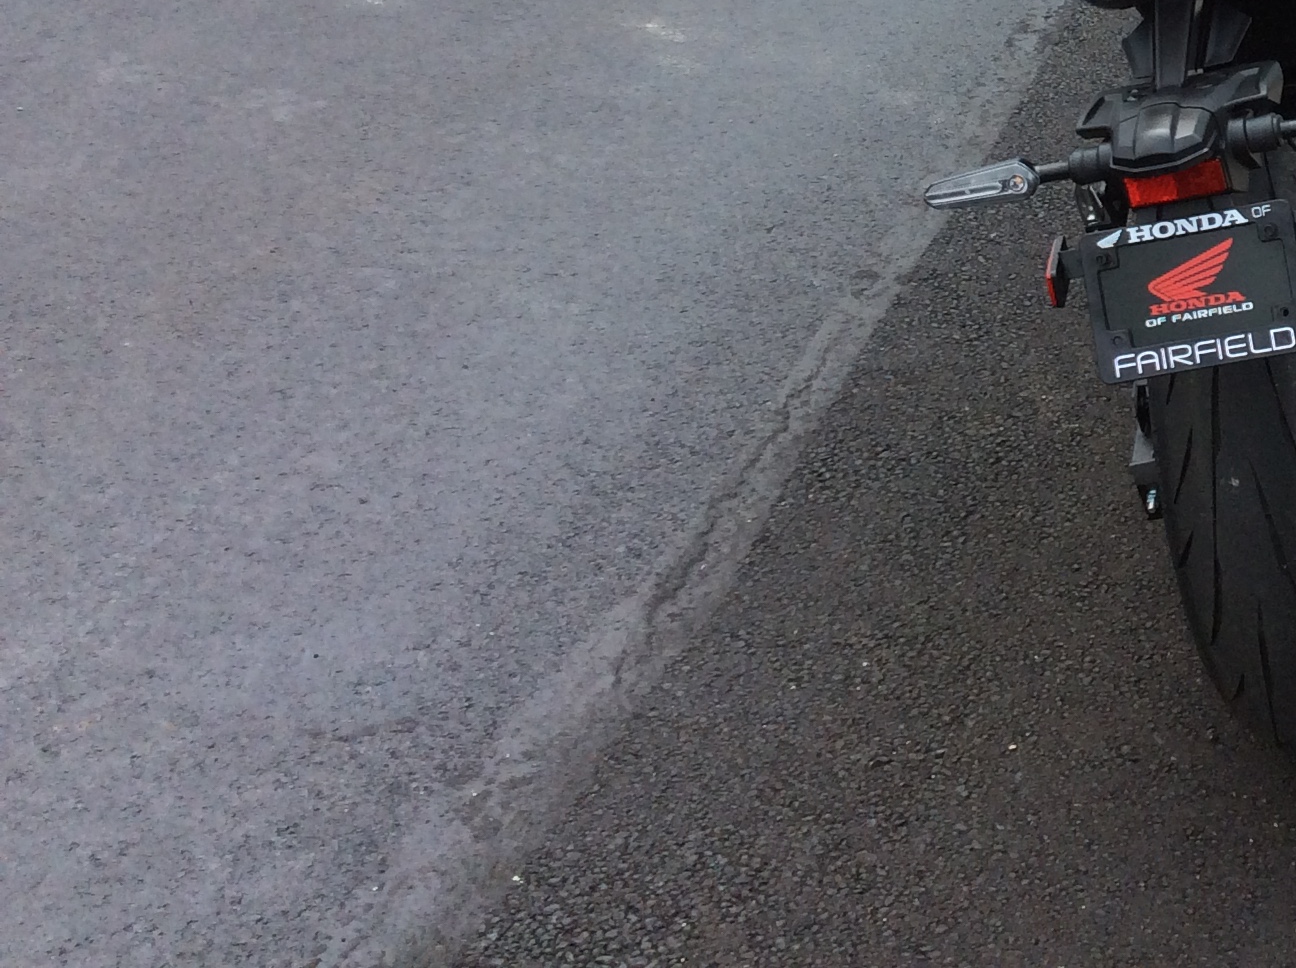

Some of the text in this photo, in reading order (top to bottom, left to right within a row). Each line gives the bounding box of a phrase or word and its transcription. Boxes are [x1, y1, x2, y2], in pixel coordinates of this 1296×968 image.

[1127, 204, 1272, 244] HONDA OF
[1145, 301, 1254, 328] OF FAIRFIELD
[1148, 291, 1247, 316] HONDA
[1113, 326, 1296, 379] FAIRFIELD
